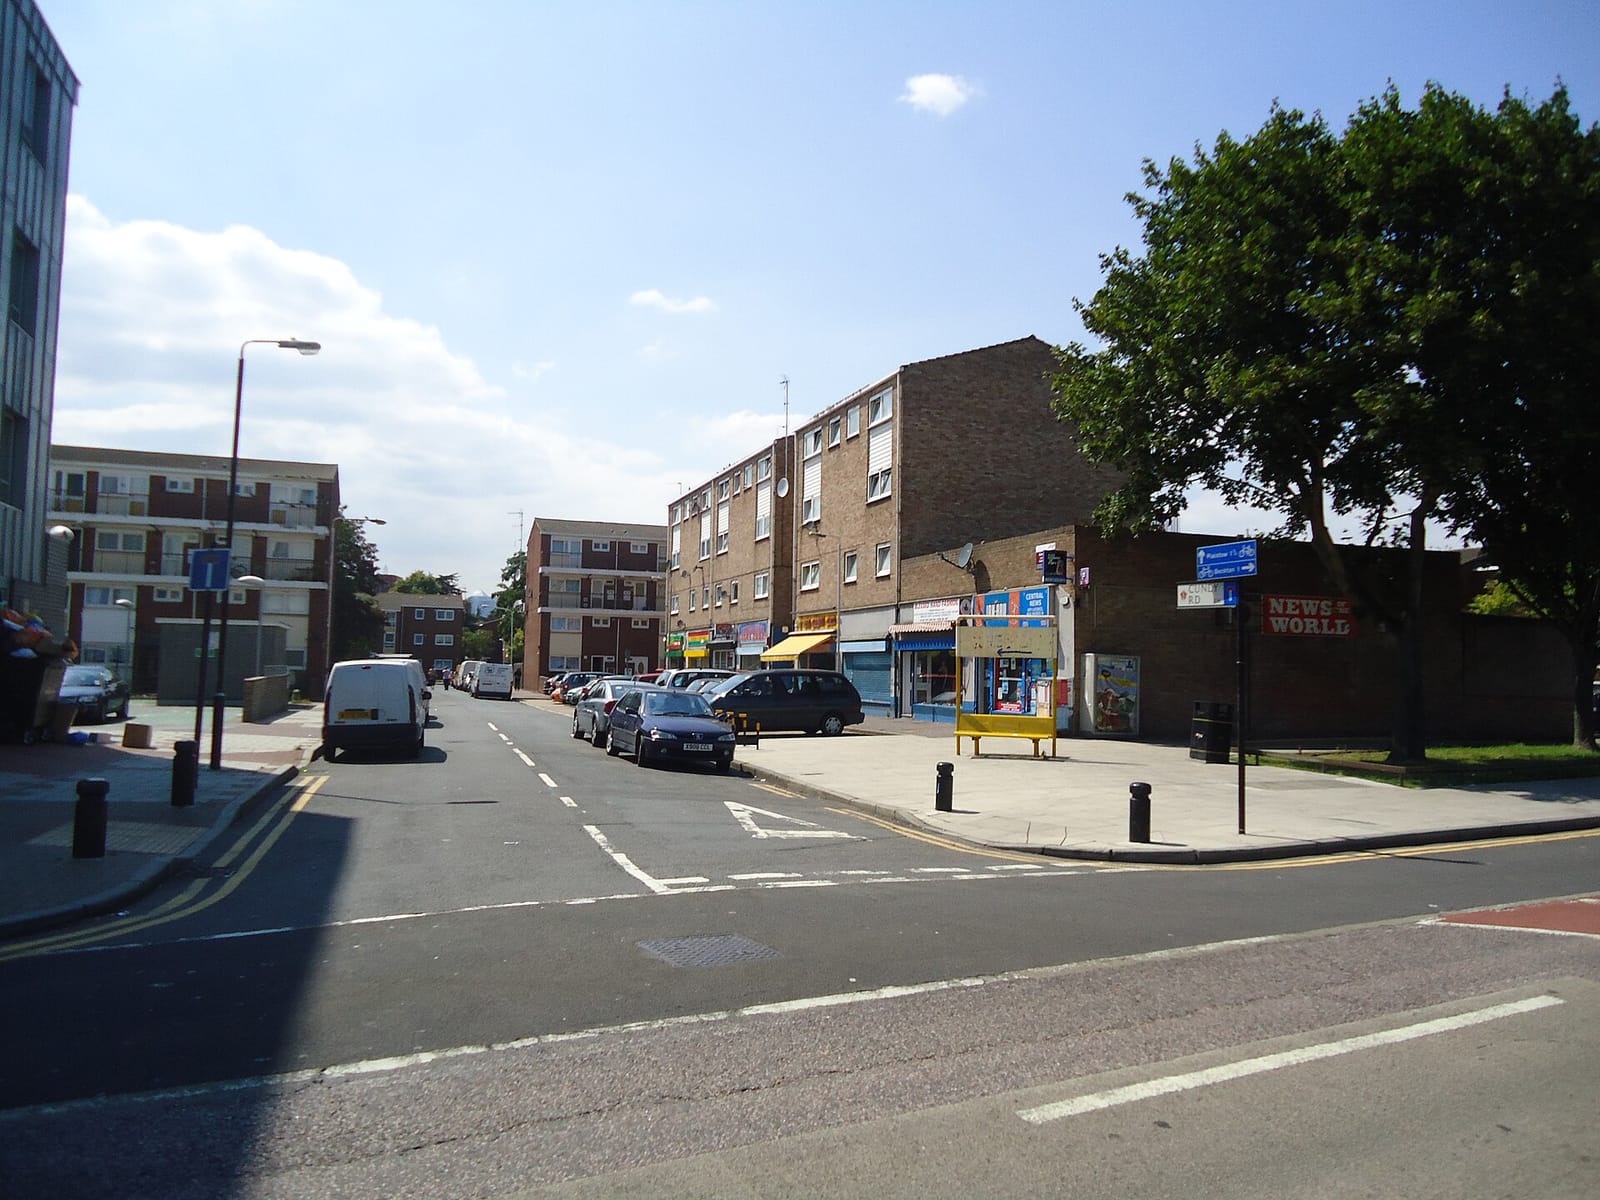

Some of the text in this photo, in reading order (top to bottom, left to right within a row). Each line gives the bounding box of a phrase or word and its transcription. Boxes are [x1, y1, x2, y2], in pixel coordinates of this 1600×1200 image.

[1188, 583, 1219, 594] CUNDY
[1026, 592, 1044, 600] CENTRAL
[1188, 595, 1201, 604] RD
[1029, 599, 1042, 607] NEWS
[1268, 598, 1332, 616] NEWS
[1269, 617, 1351, 634] WORLD
